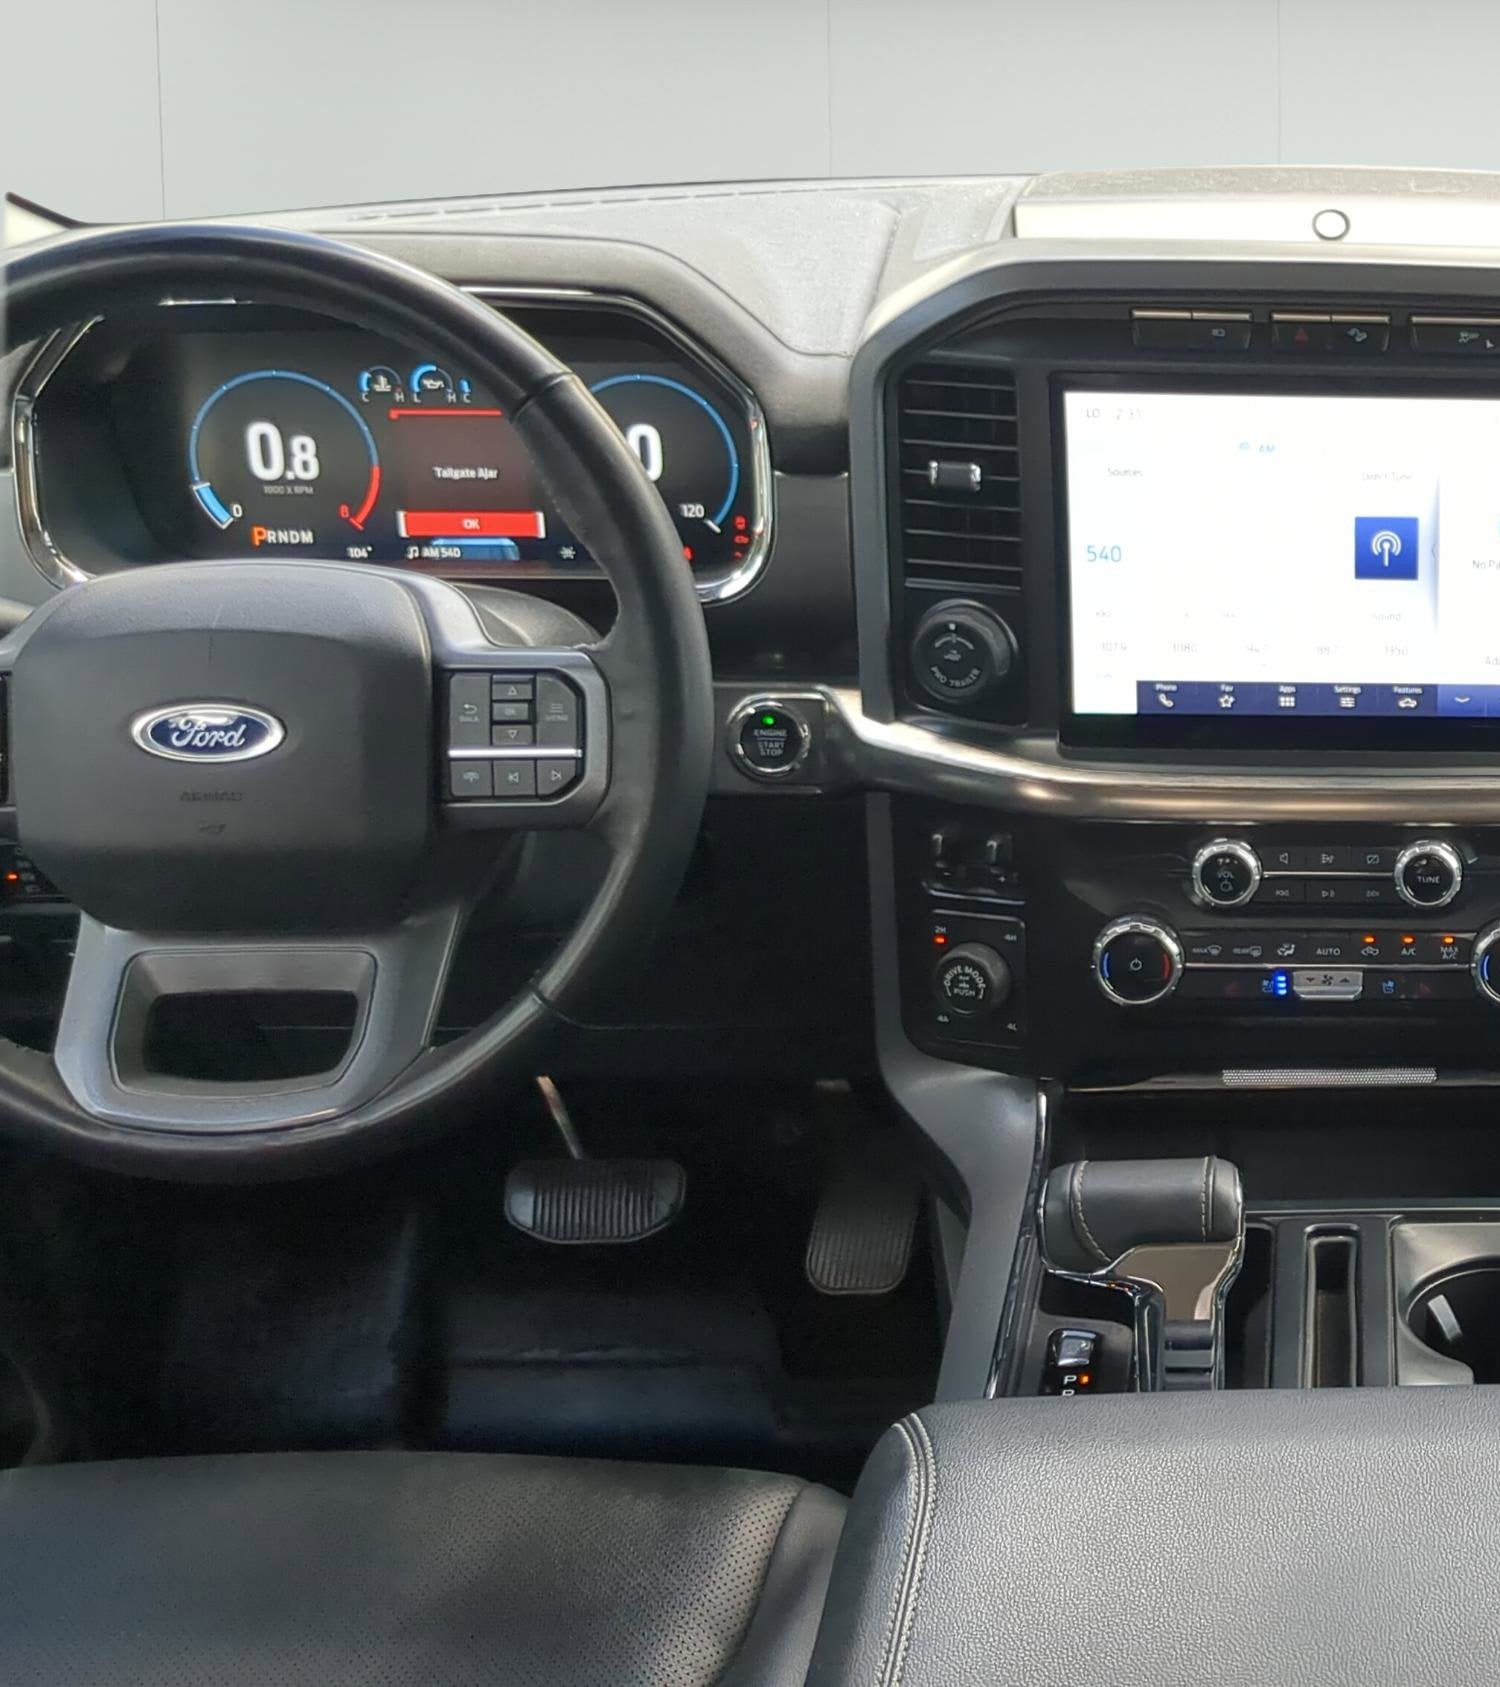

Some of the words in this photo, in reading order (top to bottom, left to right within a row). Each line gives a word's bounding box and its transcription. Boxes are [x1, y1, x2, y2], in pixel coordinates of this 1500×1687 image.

[246, 421, 320, 481] 0.8
[433, 467, 476, 480] Tailgate
[478, 467, 498, 480] Ajar
[232, 504, 242, 518] 0
[679, 504, 705, 518] 120
[463, 518, 480, 530] OK
[421, 547, 440, 558] AM
[441, 547, 461, 558] 540
[1086, 545, 1122, 563] 540
[1472, 559, 1487, 569] No
[1155, 683, 1178, 692] Phone
[1220, 684, 1234, 693] Fav
[1279, 685, 1297, 694] Apps
[1334, 685, 1361, 695] Settings
[1393, 686, 1422, 695] Features
[168, 714, 246, 748] Ford
[1416, 875, 1441, 884] TUNE
[1316, 948, 1341, 956] AUTO
[1401, 948, 1416, 956] A/C
[943, 964, 963, 987] DRIVE
[964, 965, 987, 989] MODE
[1064, 1375, 1077, 1384] P
